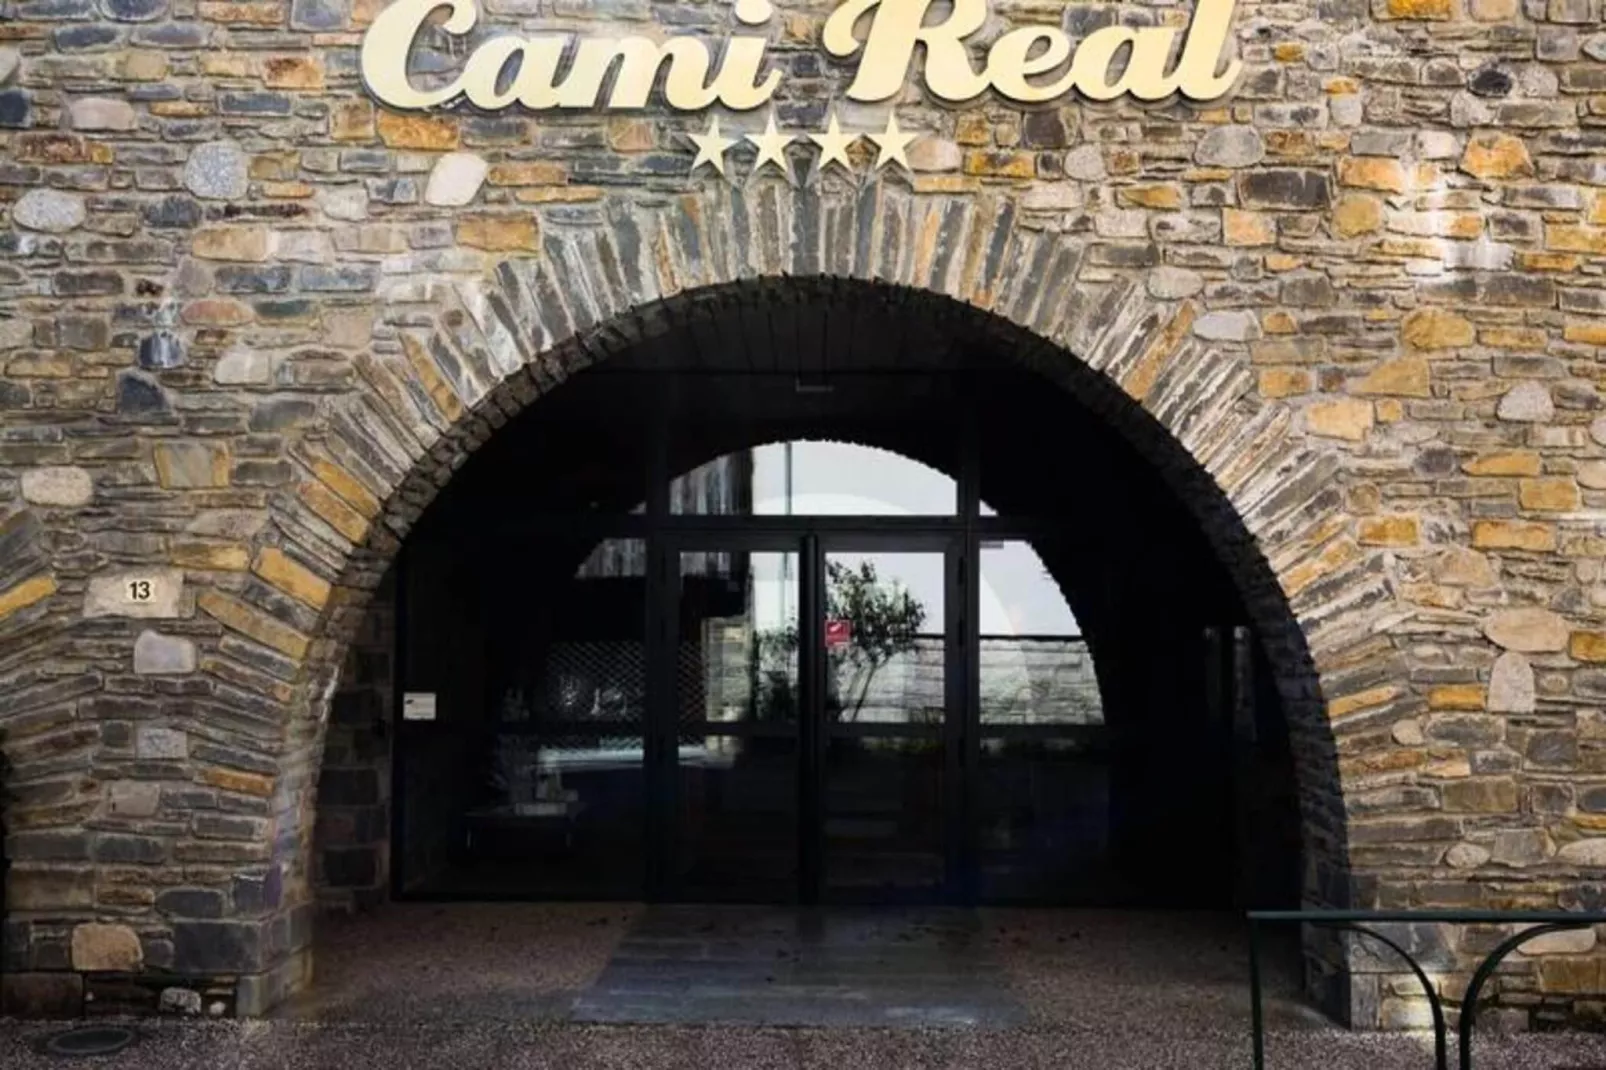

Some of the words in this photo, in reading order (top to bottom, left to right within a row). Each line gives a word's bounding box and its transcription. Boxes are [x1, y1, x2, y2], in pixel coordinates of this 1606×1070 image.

[361, 0, 782, 110] Cami
[822, 0, 1242, 101] Real
[129, 581, 151, 600] 13
